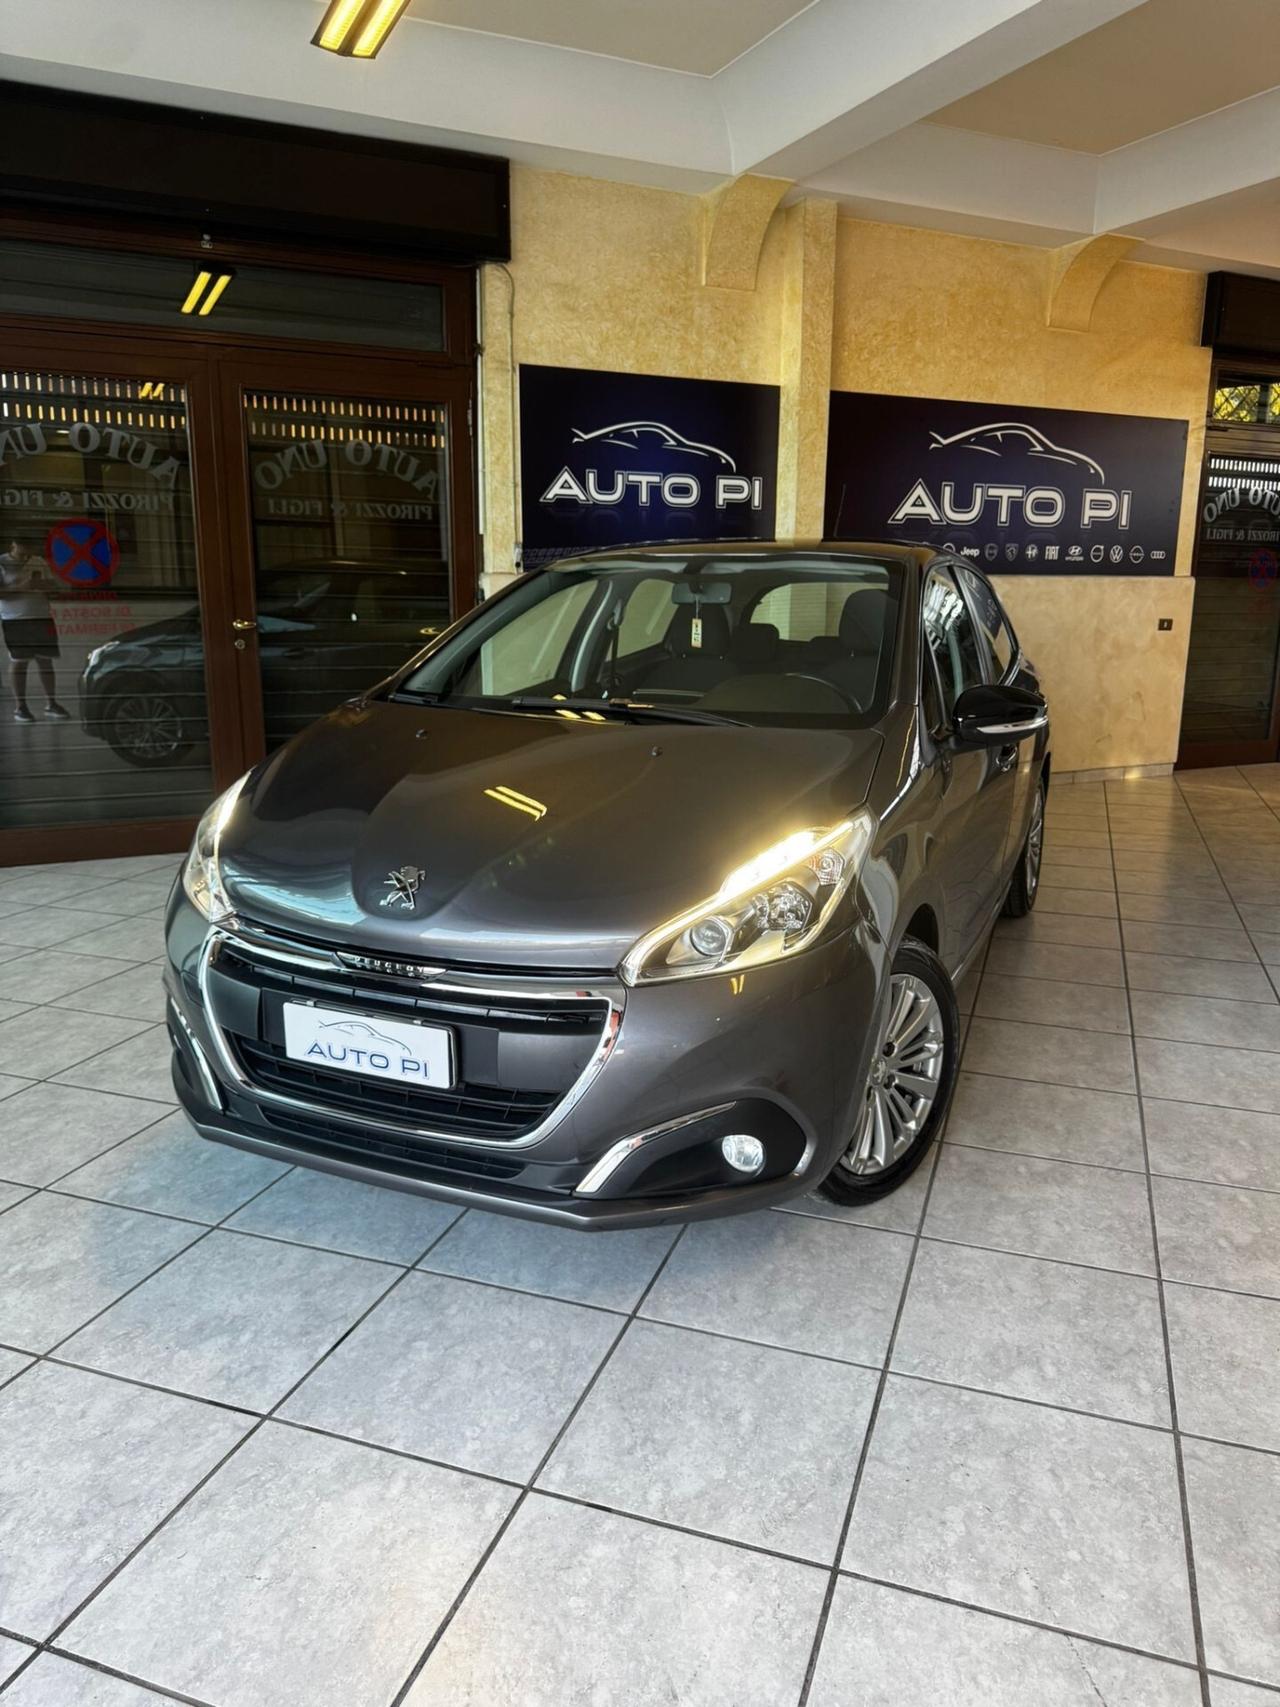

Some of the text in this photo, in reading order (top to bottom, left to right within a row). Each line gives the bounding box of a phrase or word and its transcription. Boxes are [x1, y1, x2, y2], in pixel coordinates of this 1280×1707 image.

[539, 466, 762, 510] AUTO PI
[887, 478, 1132, 530] AUTO PI
[960, 546, 980, 557] Jeep
[1045, 545, 1060, 560] FIAT
[306, 1041, 429, 1078] AUTO PI
